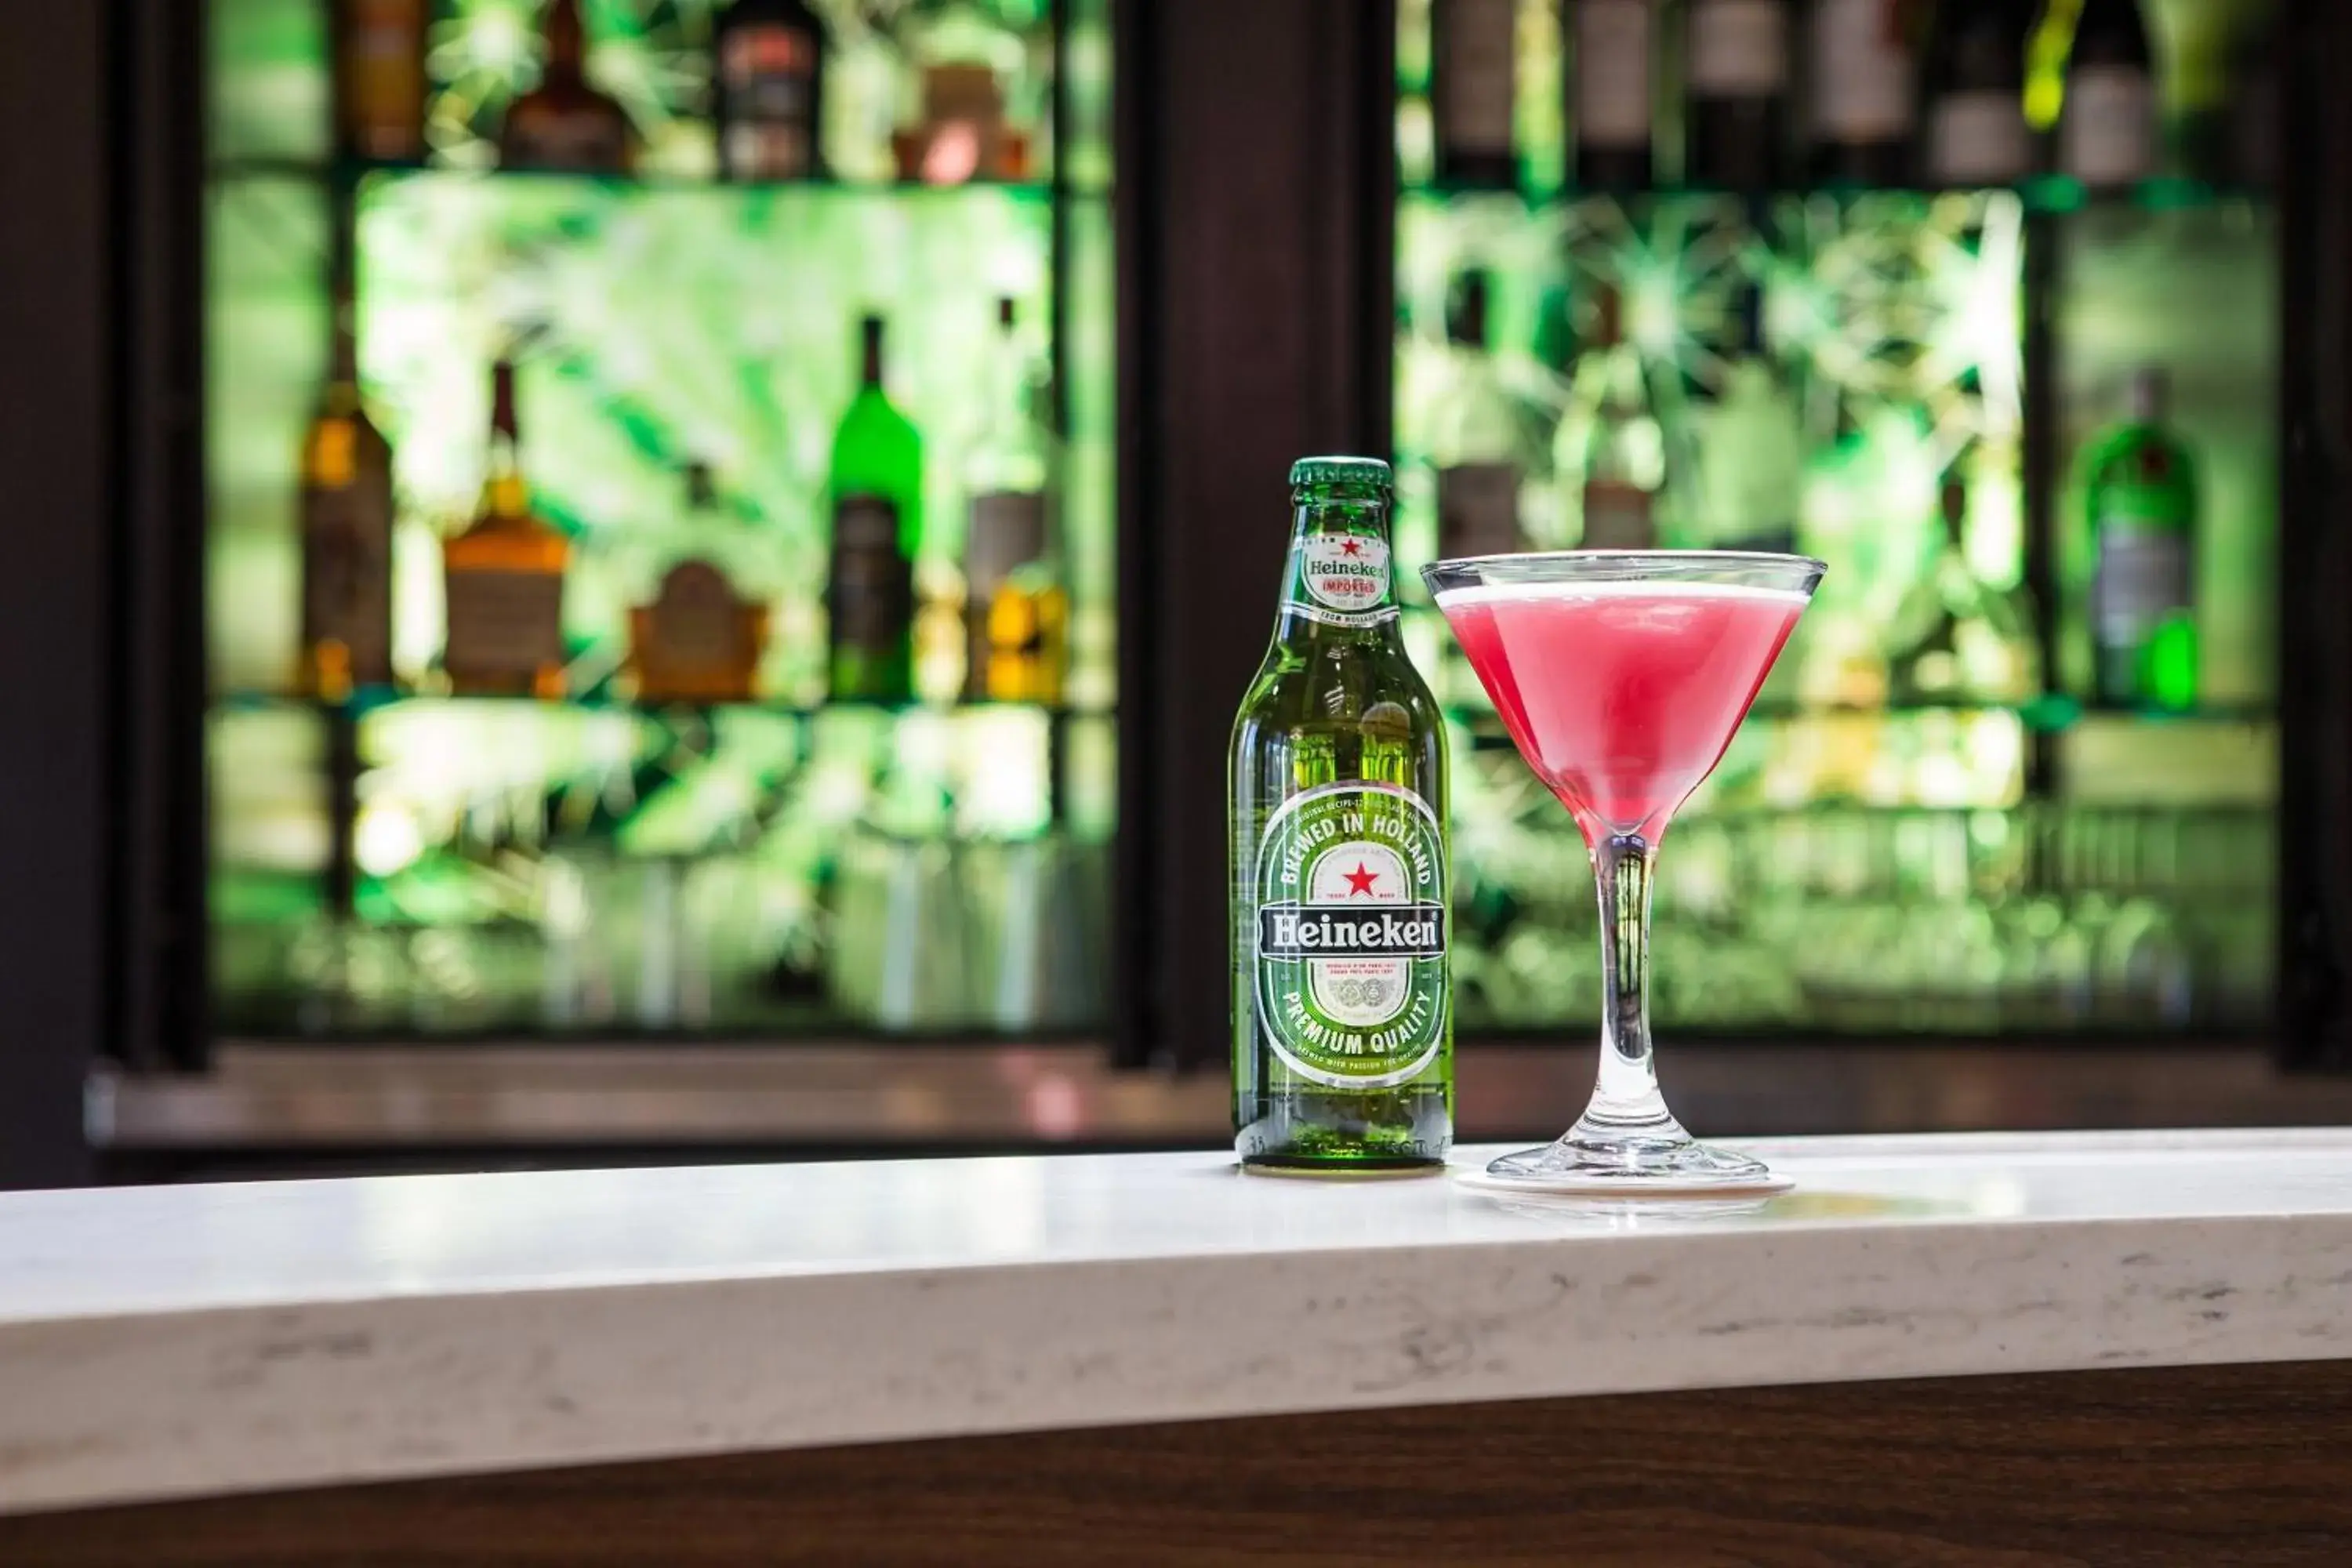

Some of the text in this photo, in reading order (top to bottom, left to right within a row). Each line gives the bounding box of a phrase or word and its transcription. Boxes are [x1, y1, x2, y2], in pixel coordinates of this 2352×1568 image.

[1323, 579, 1375, 593] IMPORTED
[1280, 813, 1431, 885] BREWED IN HOLLAND
[1272, 914, 1437, 947] Heineken
[1283, 990, 1431, 1054] PREMIUM QUALITY
